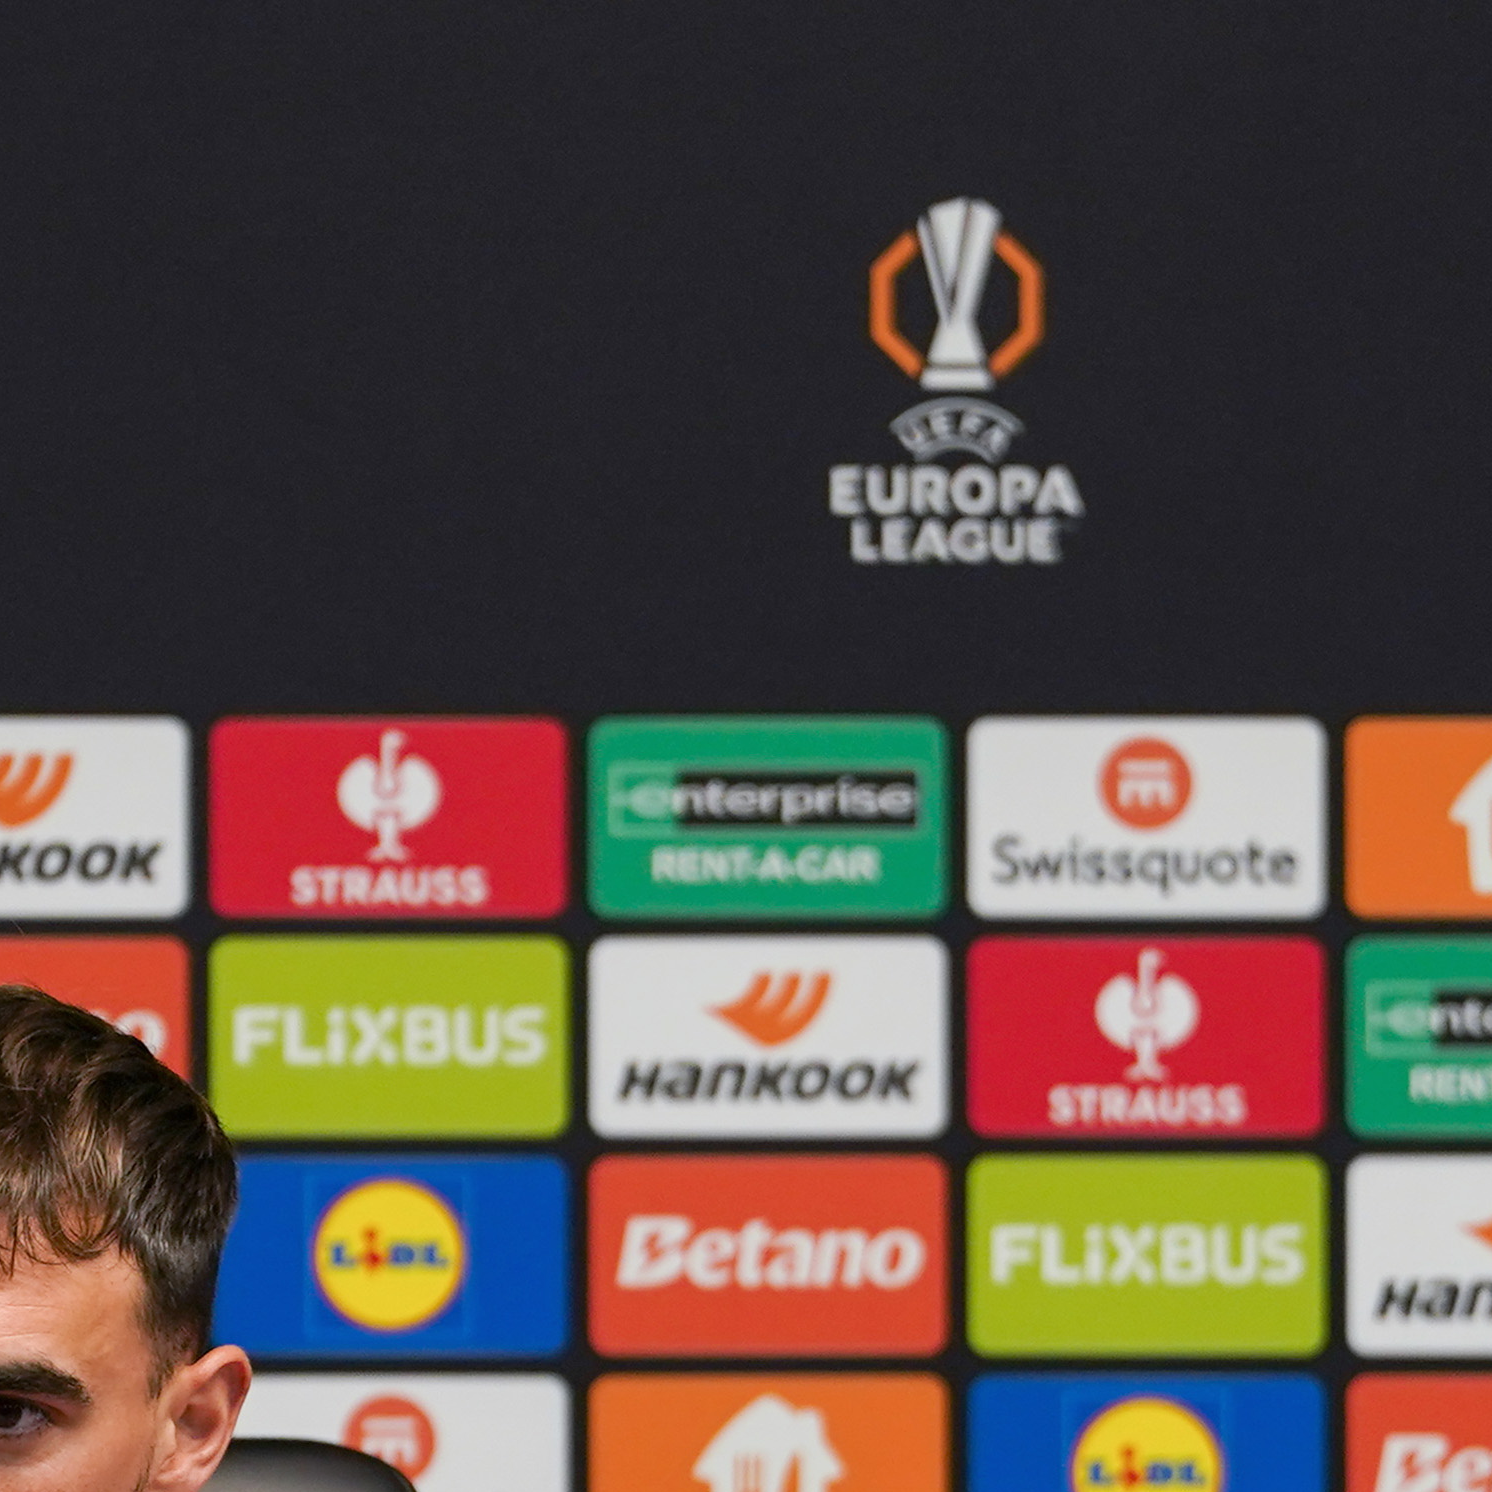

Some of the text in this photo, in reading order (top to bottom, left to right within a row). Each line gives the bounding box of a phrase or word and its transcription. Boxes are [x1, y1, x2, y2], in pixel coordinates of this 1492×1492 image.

[829, 464, 1084, 516] EUROPA
[850, 517, 1060, 564] LEAGUE
[629, 774, 915, 826] enterprise
[290, 866, 489, 906] STRAUSS
[650, 846, 882, 884] RENT-A-CAR
[992, 834, 1299, 891] Swissquote
[1048, 1084, 1246, 1126] STRAUSS
[616, 1215, 926, 1289] Betano
